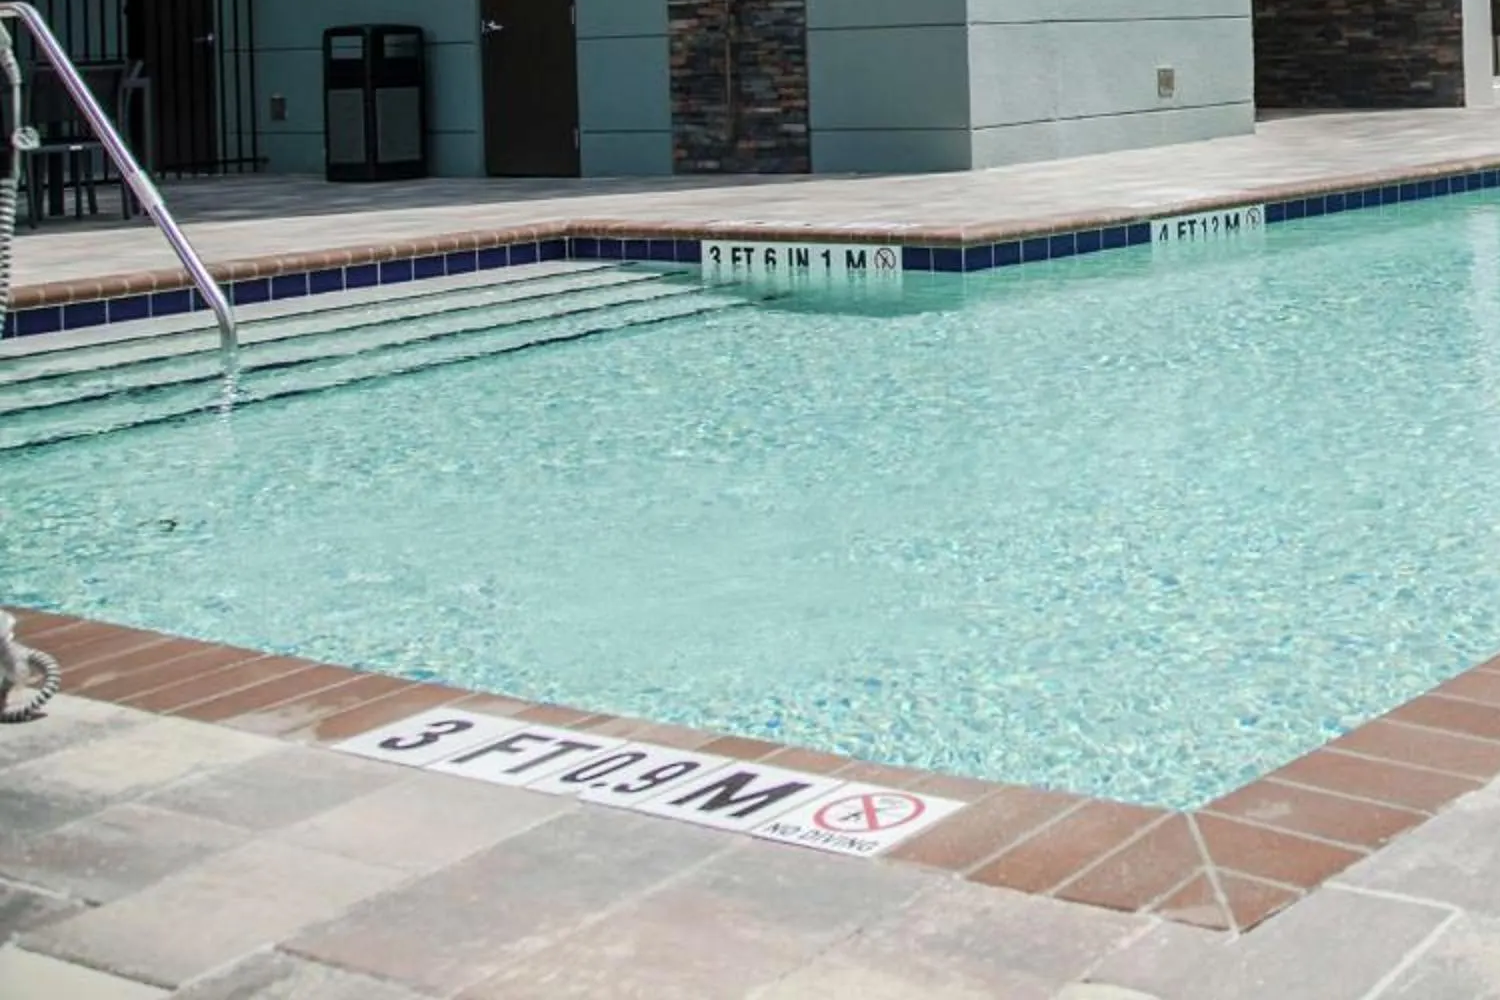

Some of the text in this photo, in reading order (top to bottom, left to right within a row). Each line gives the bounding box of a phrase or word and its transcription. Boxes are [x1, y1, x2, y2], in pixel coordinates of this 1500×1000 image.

[1178, 219, 1196, 239] FT
[1225, 212, 1240, 229] M
[709, 245, 867, 270] 3 FT 6 IN 1 M
[378, 719, 811, 819] 3 FT 0.9 M
[768, 822, 880, 852] NO DIVING
